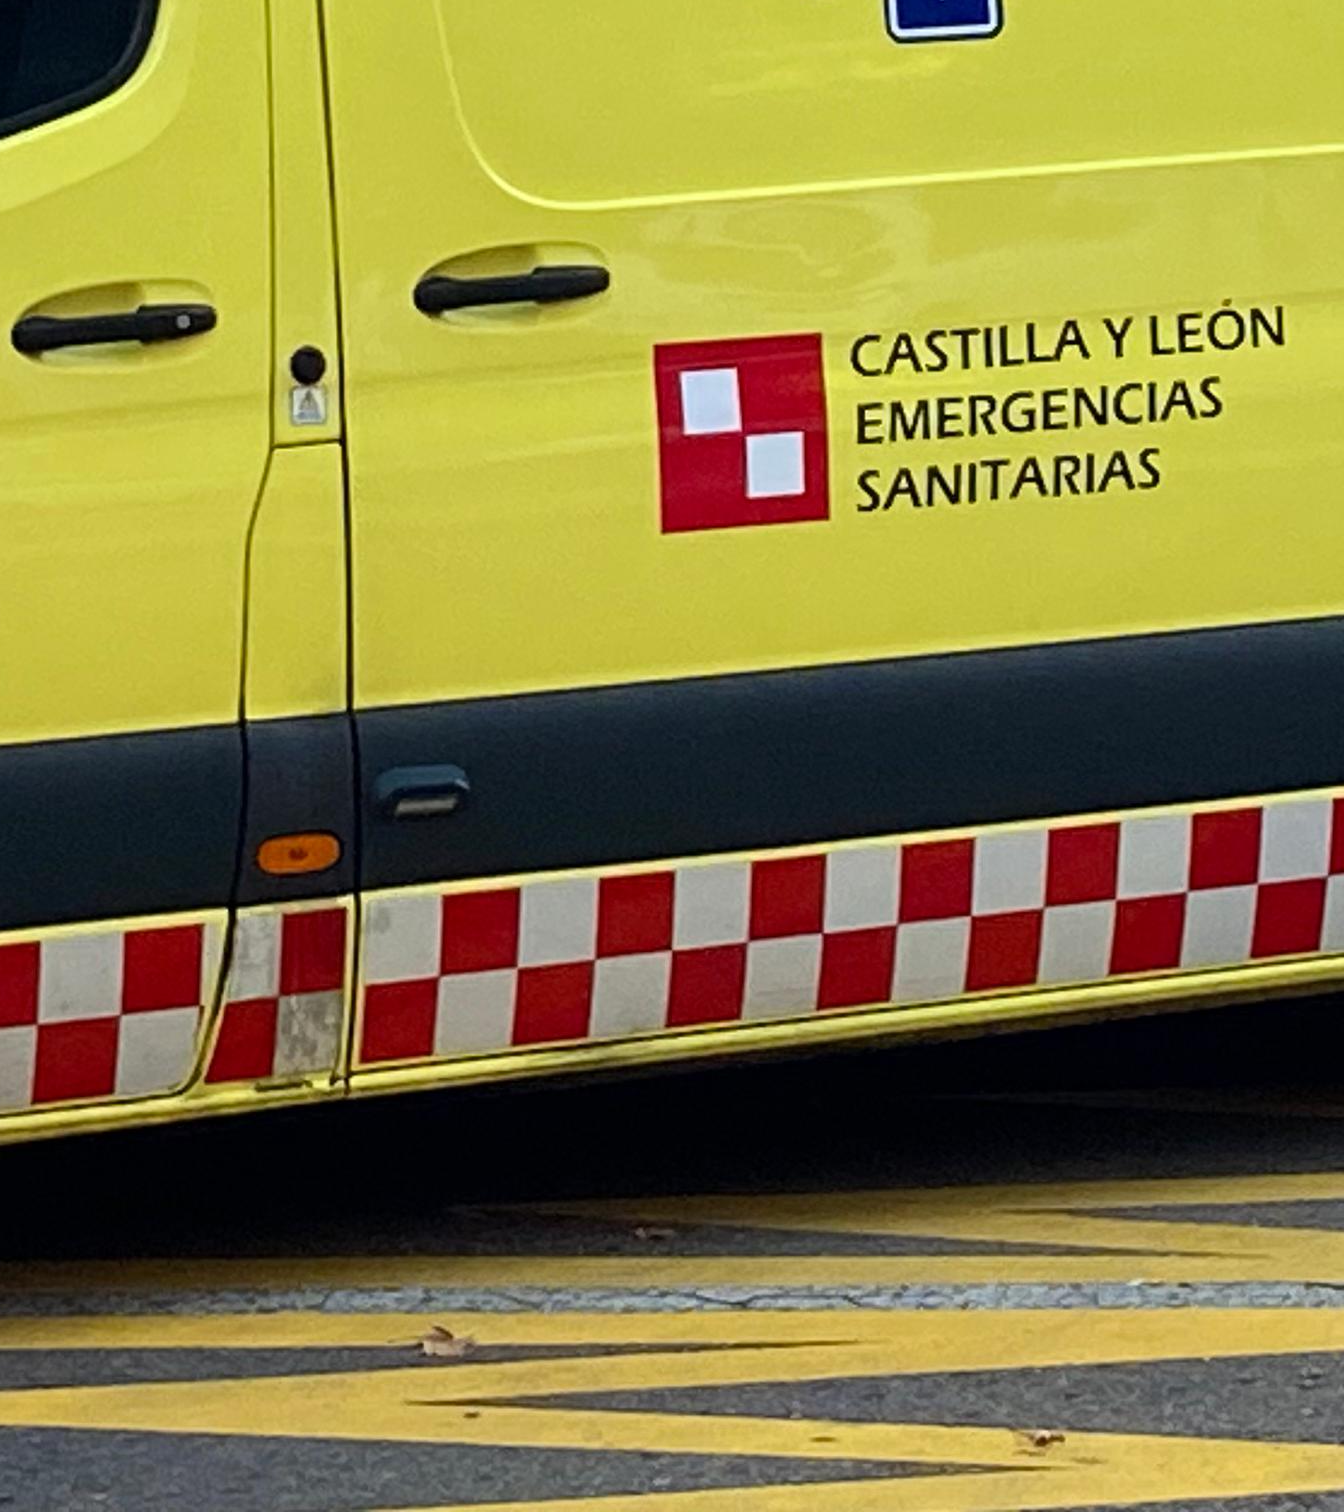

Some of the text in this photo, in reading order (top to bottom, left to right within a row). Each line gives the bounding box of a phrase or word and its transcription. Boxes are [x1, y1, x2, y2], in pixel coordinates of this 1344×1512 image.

[850, 298, 1285, 377] CASTILLA Y LEÓN
[856, 376, 1223, 444] EMERGENCIAS
[856, 447, 1160, 512] SANITARIAS
